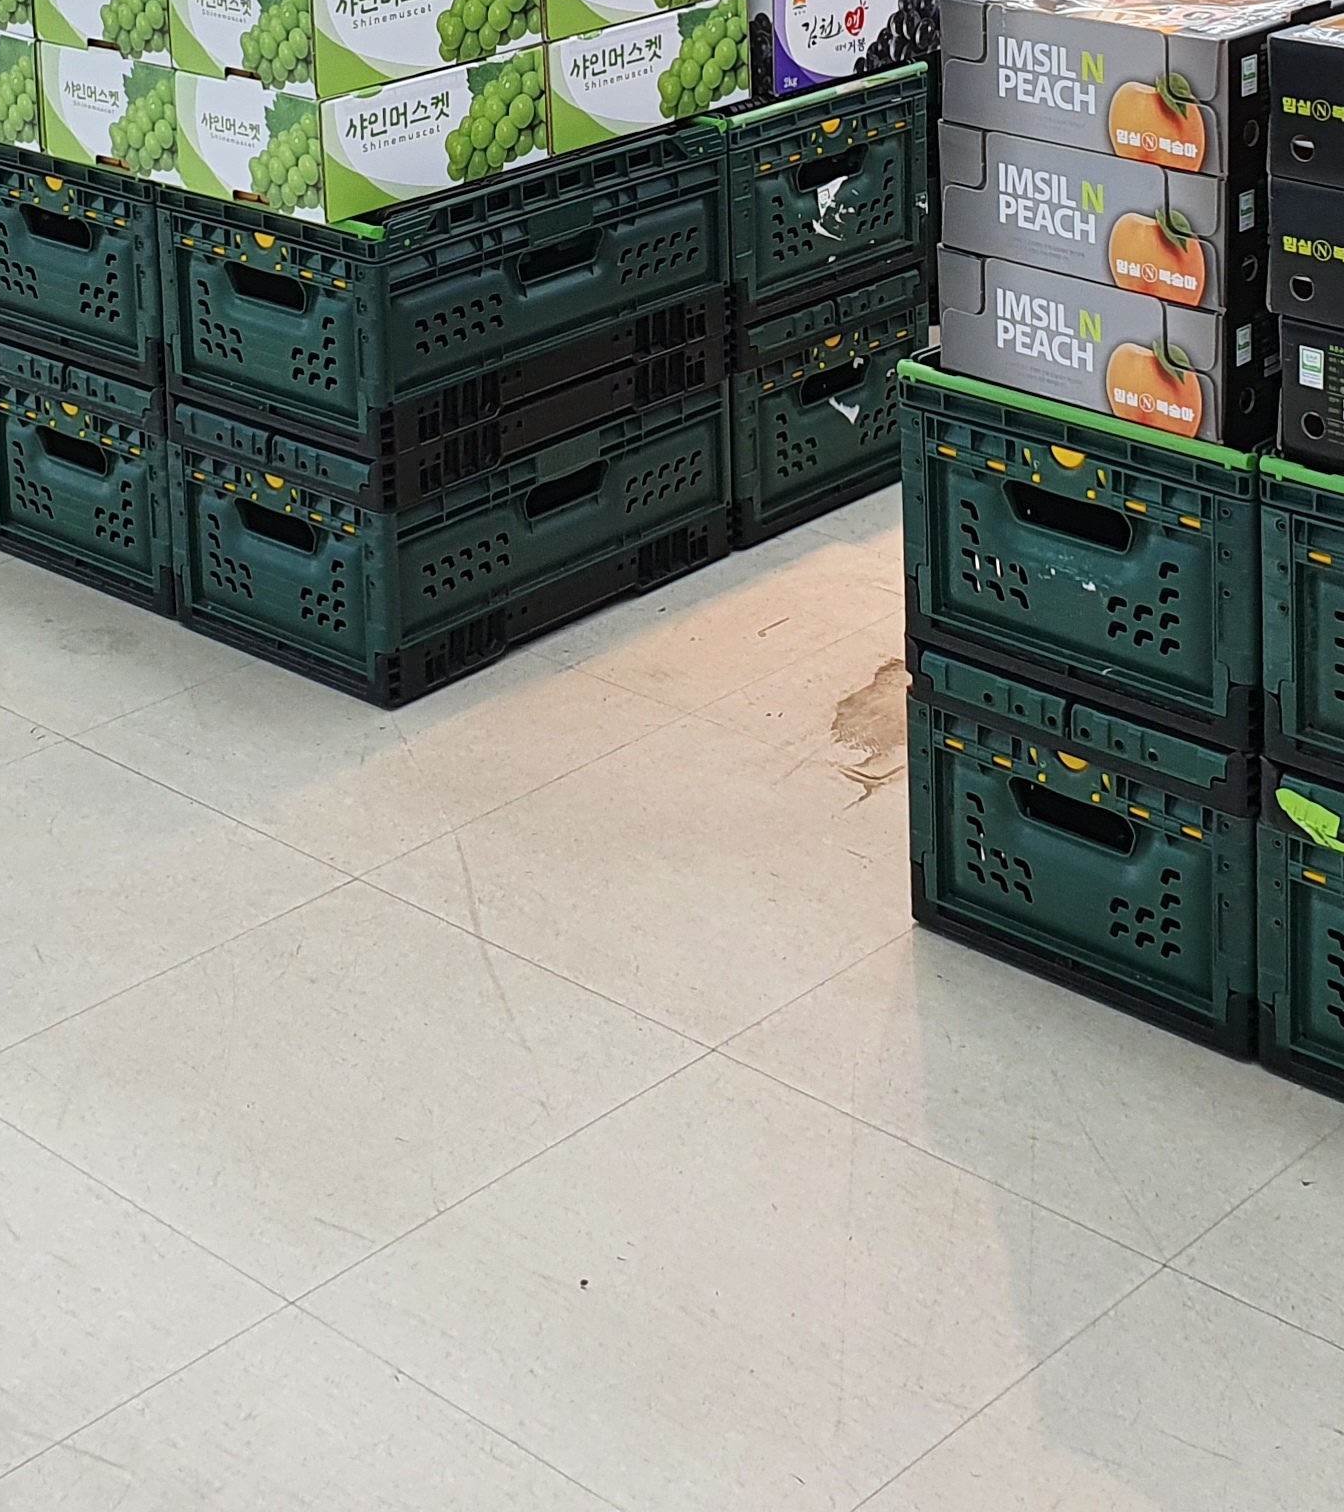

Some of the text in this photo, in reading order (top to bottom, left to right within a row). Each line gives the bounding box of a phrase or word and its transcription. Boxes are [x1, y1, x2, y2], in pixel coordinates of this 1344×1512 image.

[351, 3, 433, 31] Shinemuscat
[569, 34, 664, 81] 샤인머스켓
[783, 75, 798, 89] 2kg
[997, 35, 1105, 84] IMSIL N
[998, 67, 1096, 115] PEACH
[345, 91, 451, 141] 샤인머스켓
[361, 123, 442, 154] Shinemuscat
[998, 162, 1105, 214] IMSIL N
[998, 194, 1096, 245] PEACH
[996, 287, 1102, 343] IMSIL N
[996, 319, 1094, 373] PEACH
